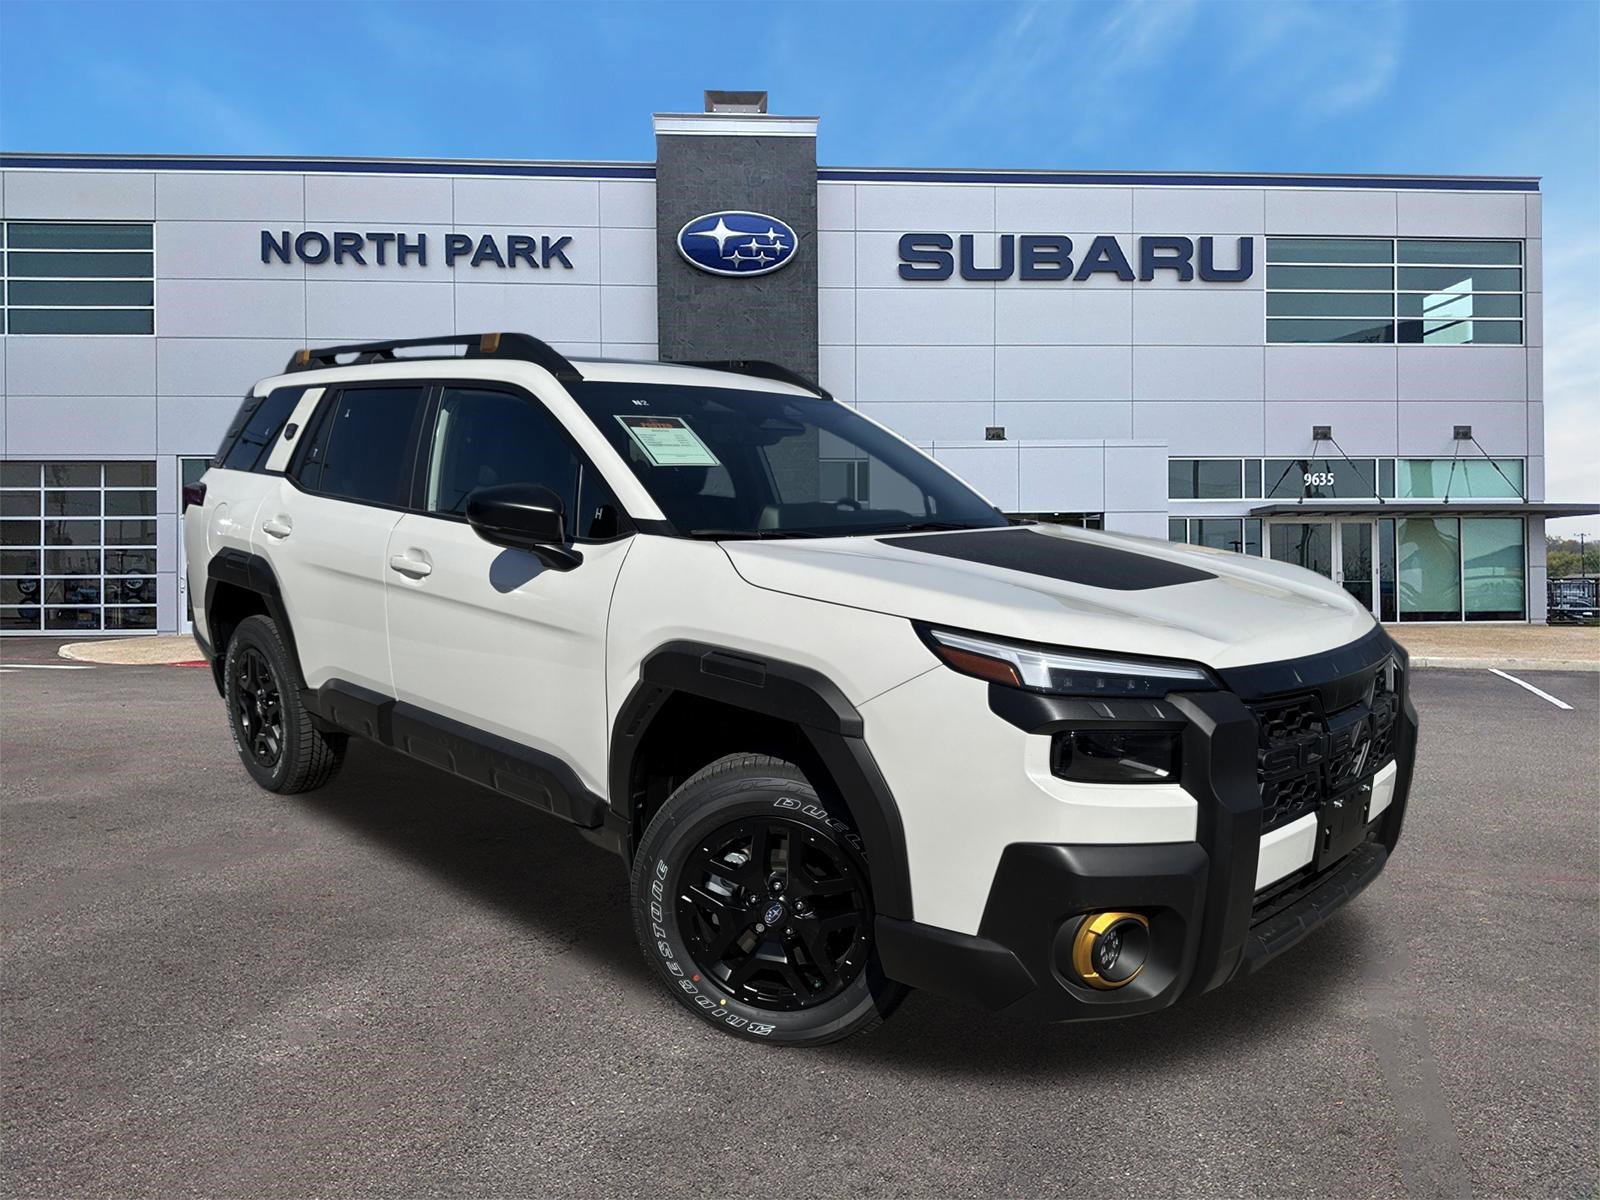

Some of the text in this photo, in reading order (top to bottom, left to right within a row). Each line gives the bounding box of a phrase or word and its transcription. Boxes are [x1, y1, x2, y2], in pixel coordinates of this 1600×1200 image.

[260, 230, 574, 270] NORTH PARK
[898, 233, 1254, 282] SUBARU
[1304, 472, 1334, 486] 9635
[650, 859, 776, 1036] BRIDGESTONE
